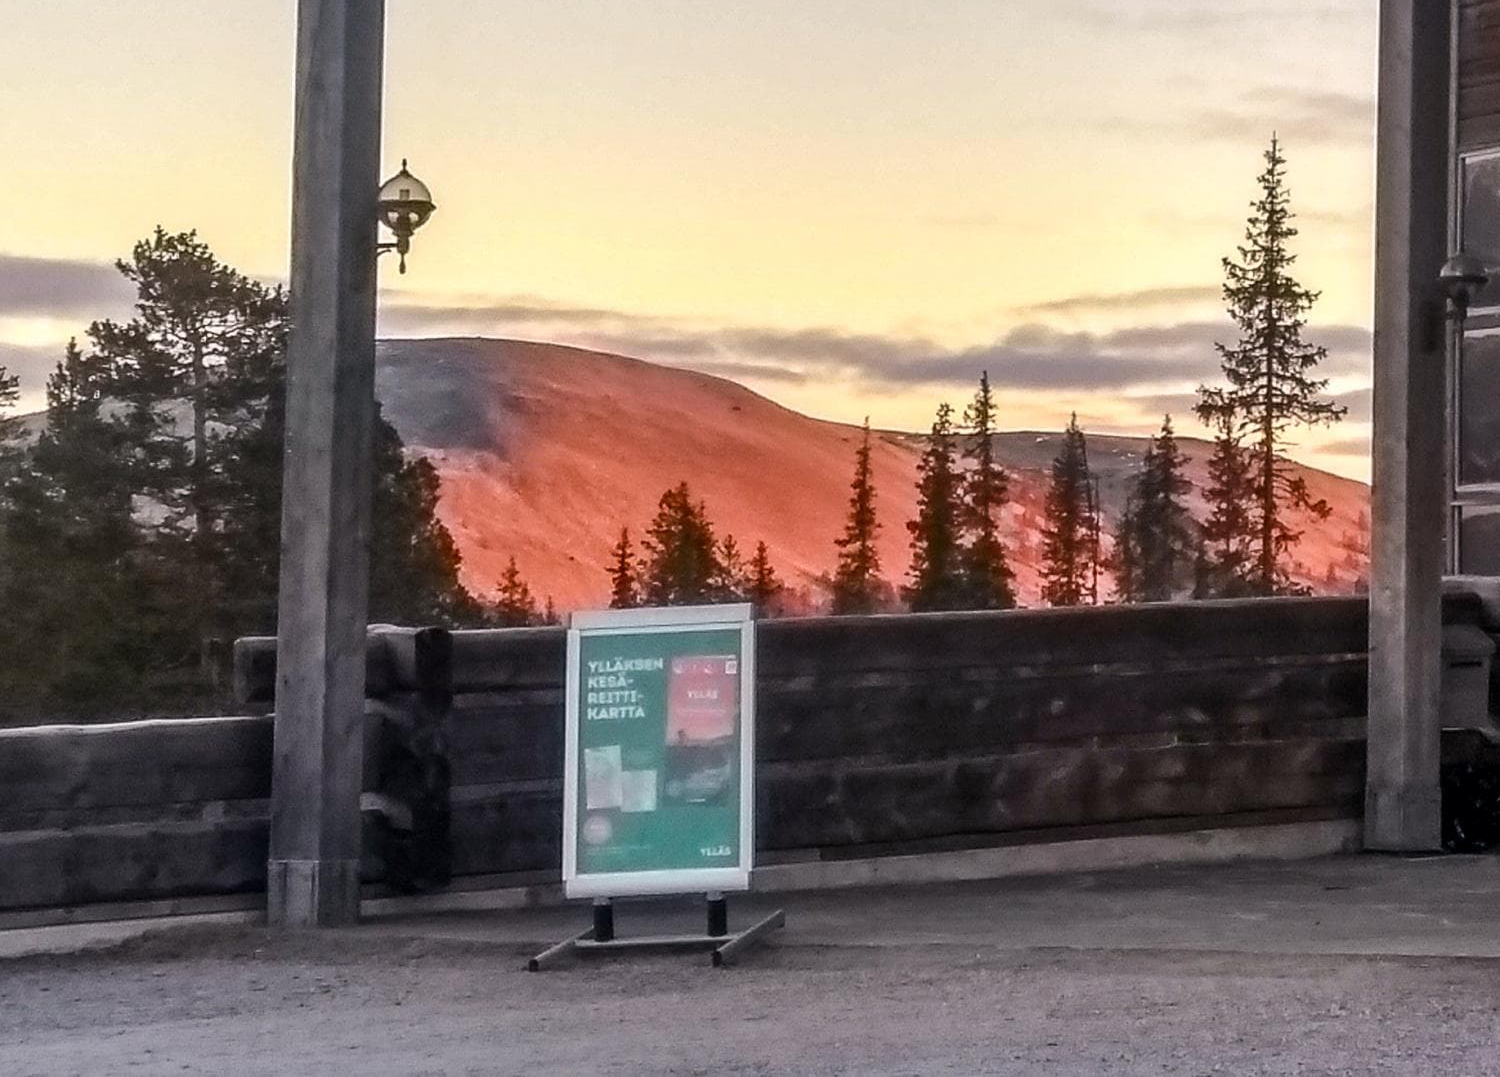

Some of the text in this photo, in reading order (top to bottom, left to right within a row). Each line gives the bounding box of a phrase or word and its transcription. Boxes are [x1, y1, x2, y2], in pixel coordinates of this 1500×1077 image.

[588, 672, 634, 689] KESÄ-
[588, 690, 644, 705] REITTI-
[587, 706, 646, 721] KARTTA
